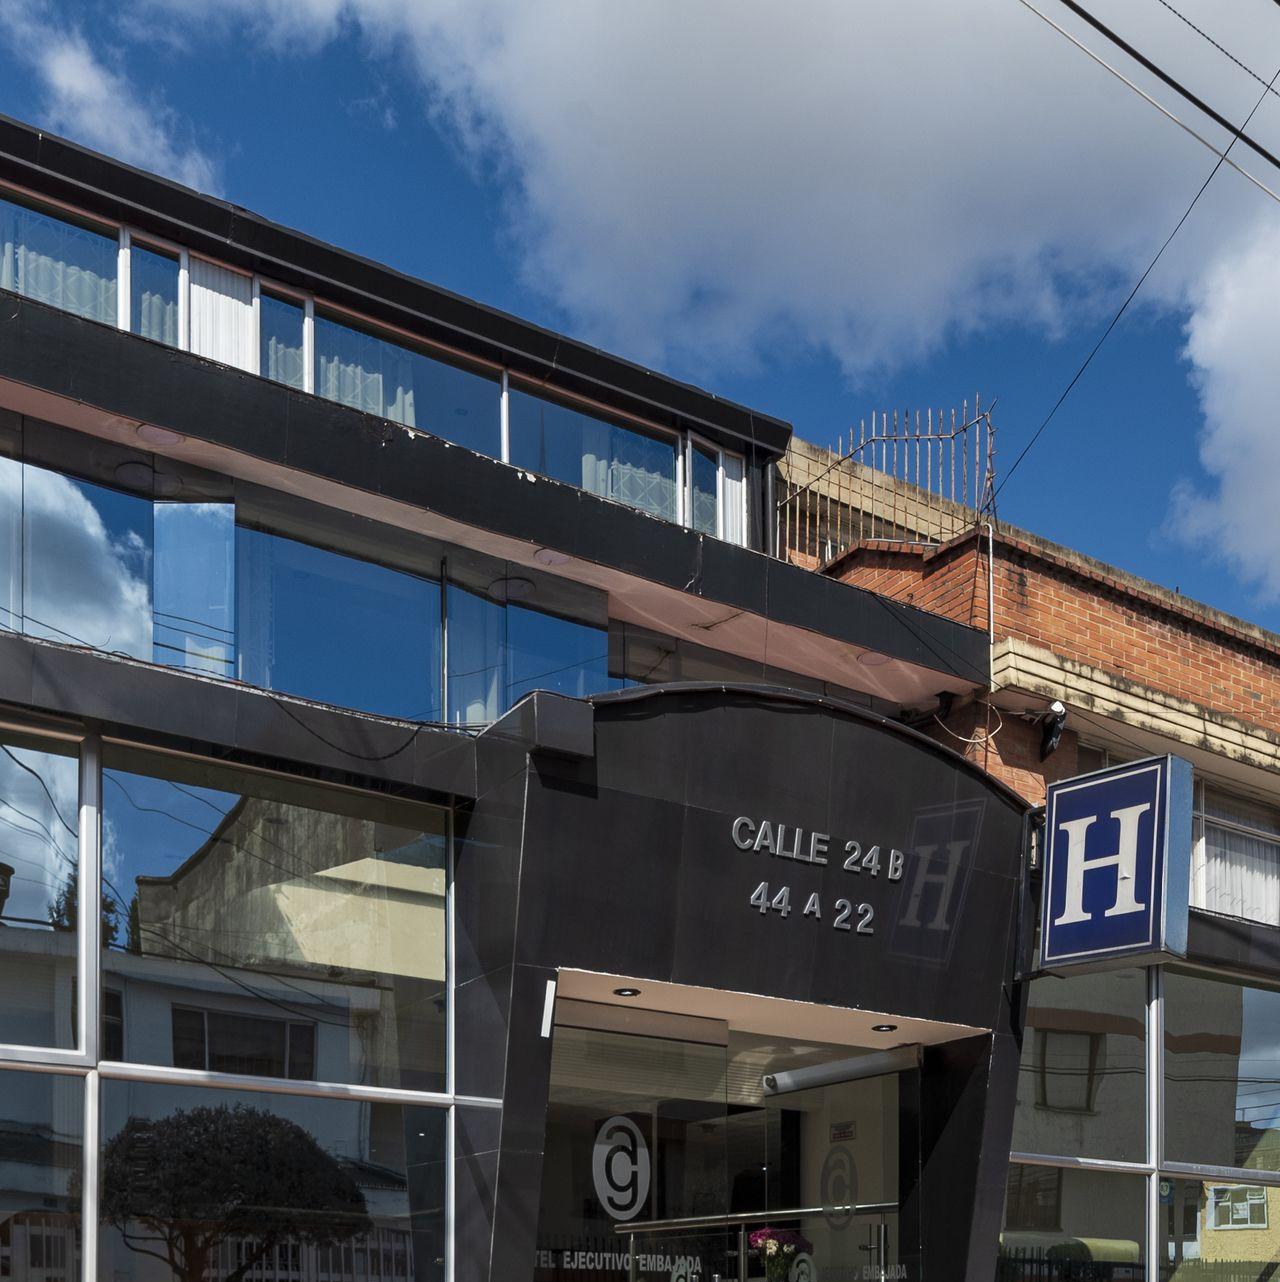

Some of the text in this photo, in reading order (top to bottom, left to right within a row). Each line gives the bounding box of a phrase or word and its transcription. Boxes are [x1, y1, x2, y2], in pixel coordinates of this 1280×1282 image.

[732, 816, 905, 881] CALLE 24 B
[1055, 802, 1151, 926] H
[750, 881, 874, 934] 44 A 22
[563, 1250, 631, 1271] EJECUTIVO
[639, 1253, 702, 1273] EMBAJADA
